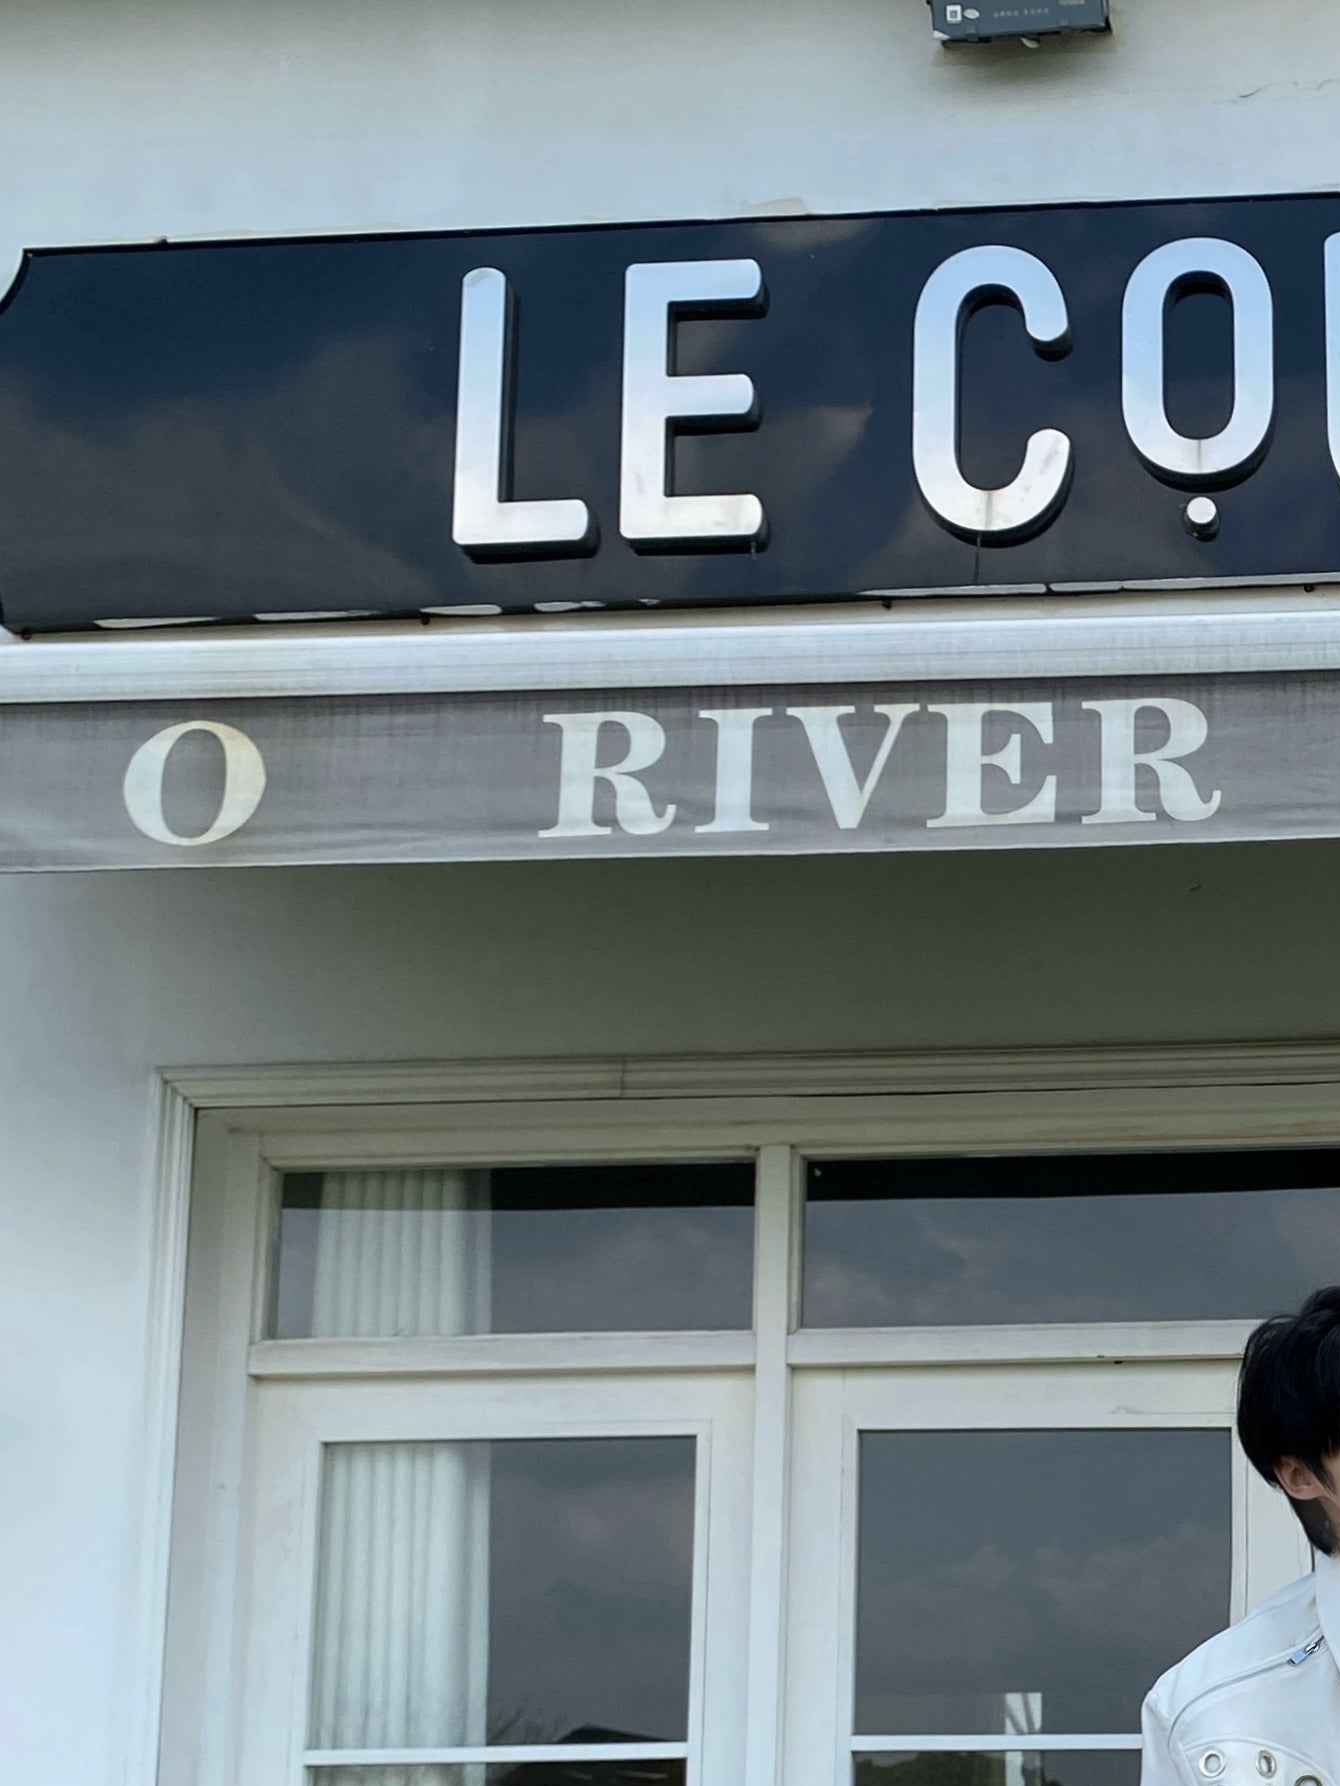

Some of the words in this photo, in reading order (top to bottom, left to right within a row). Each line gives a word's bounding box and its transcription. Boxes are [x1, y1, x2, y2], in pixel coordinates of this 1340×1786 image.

[452, 258, 764, 547] LE
[121, 719, 268, 848] O
[537, 696, 1223, 840] RIVER
